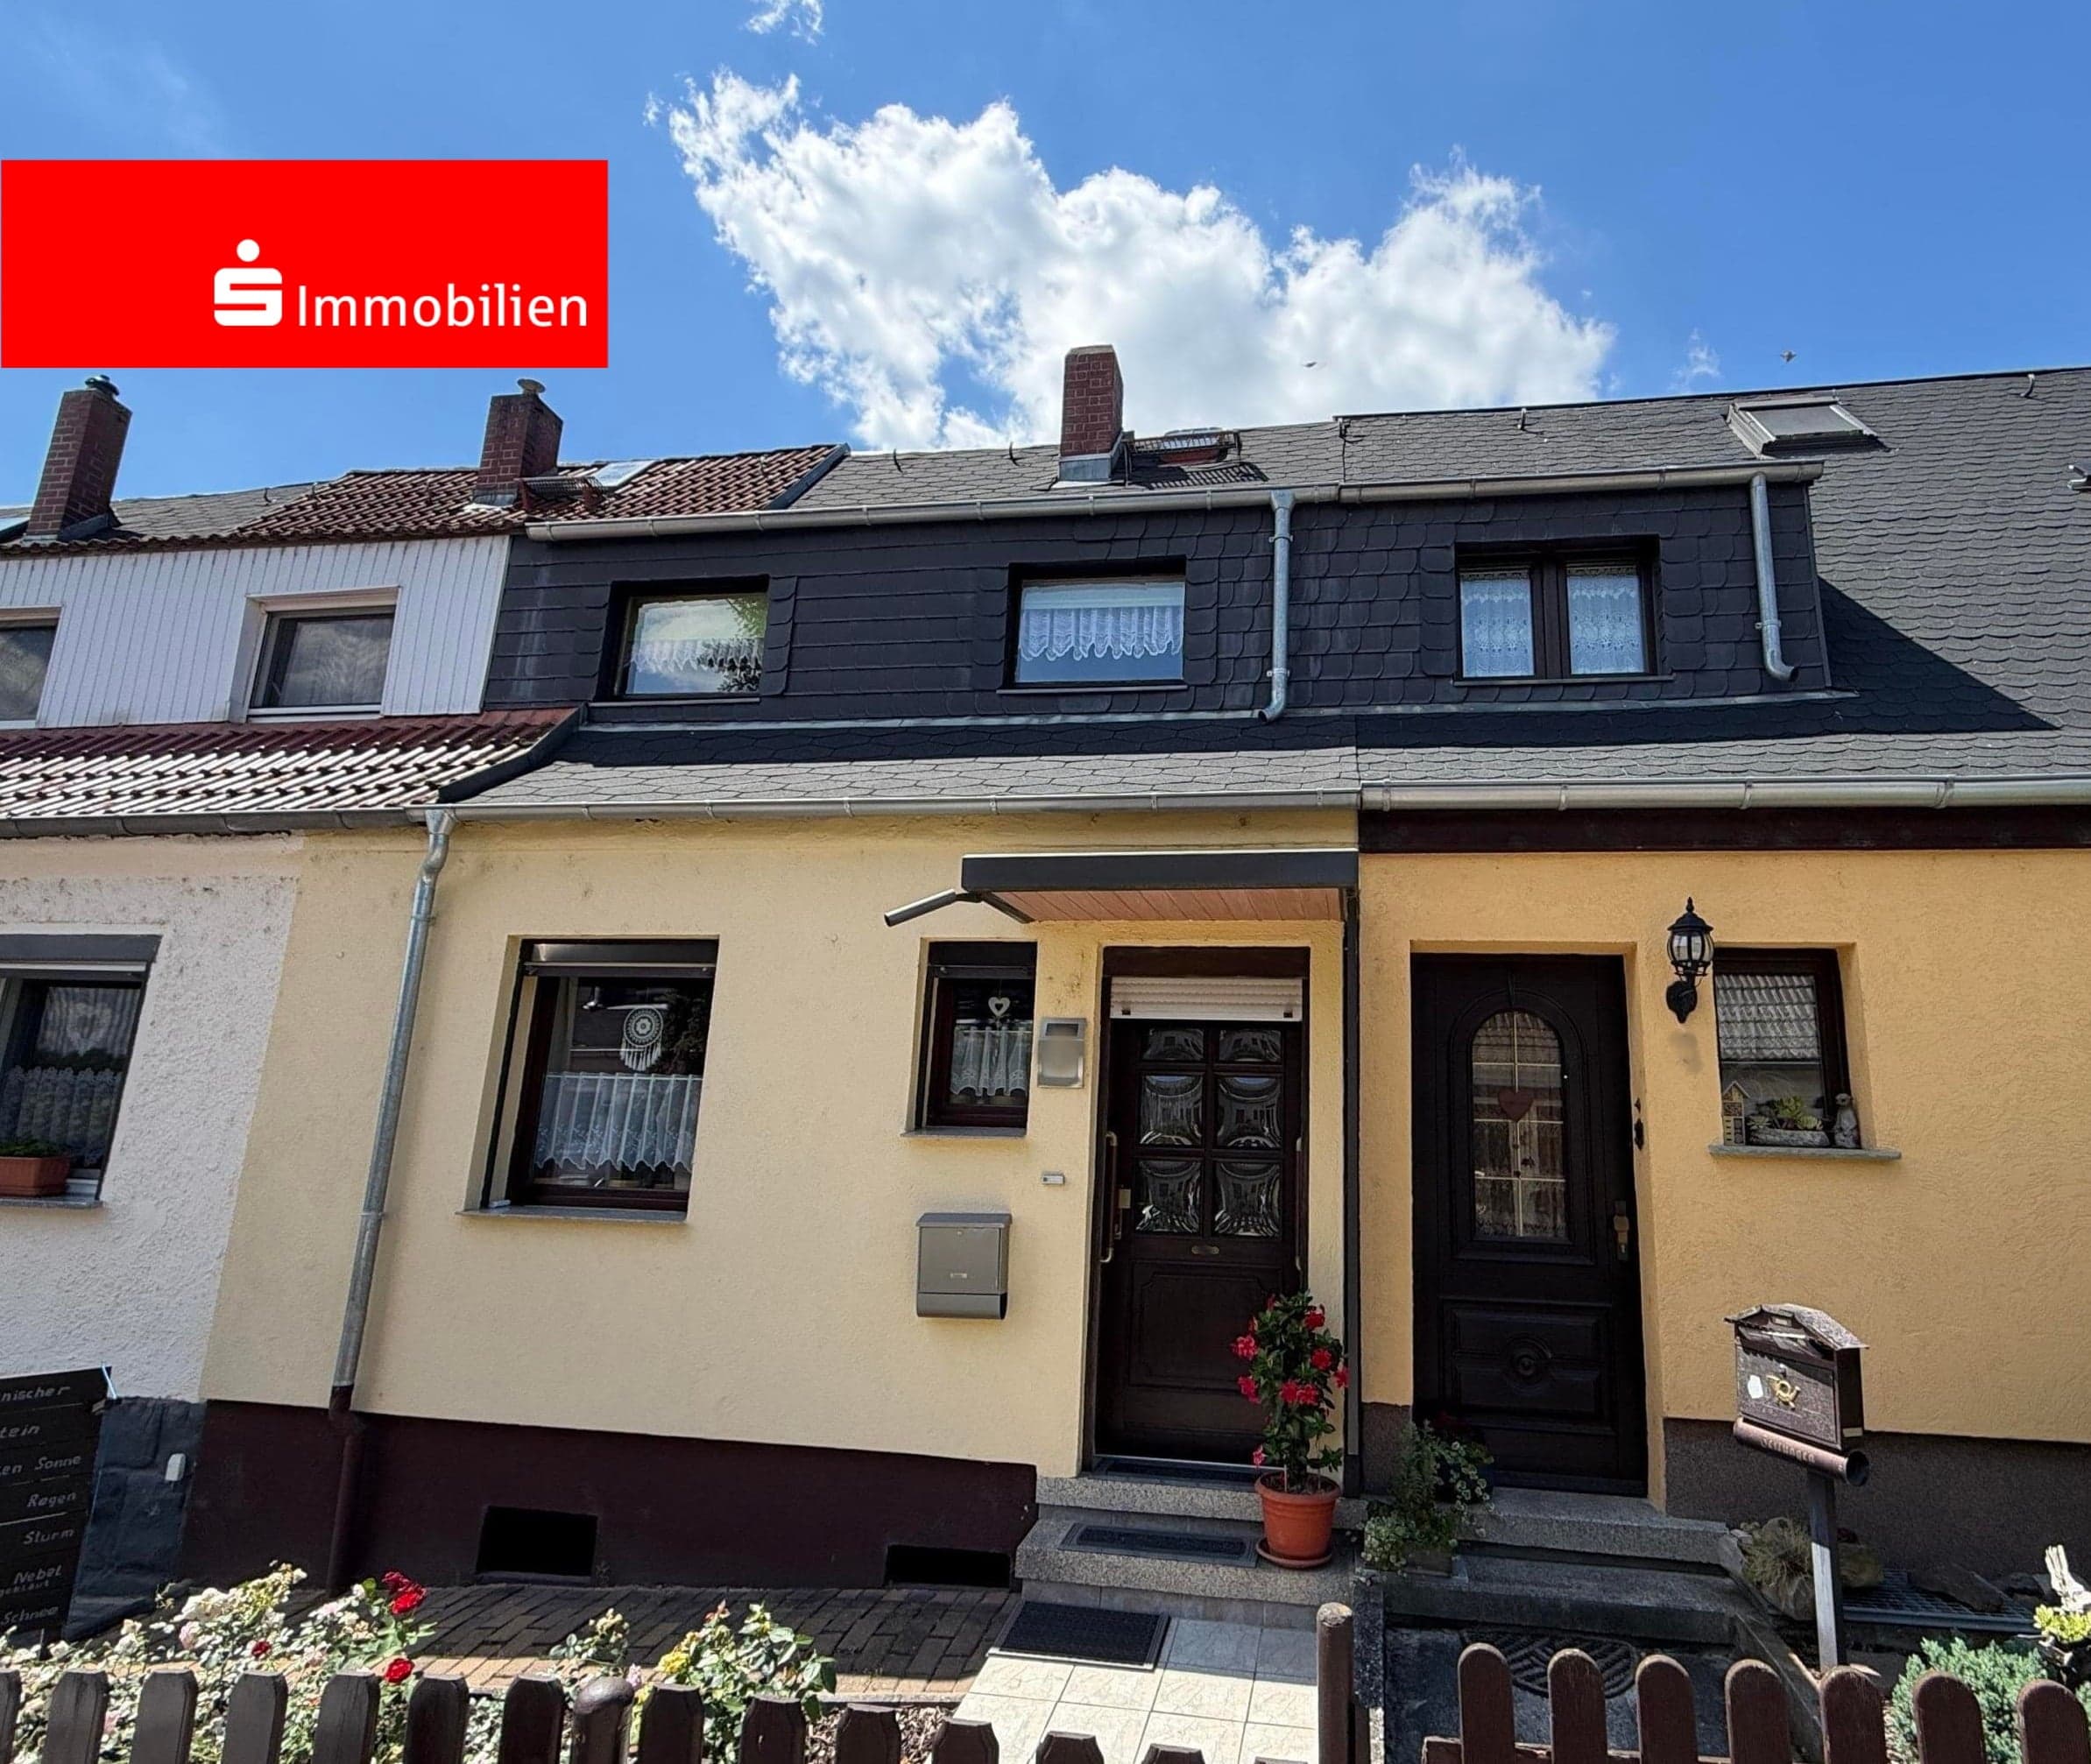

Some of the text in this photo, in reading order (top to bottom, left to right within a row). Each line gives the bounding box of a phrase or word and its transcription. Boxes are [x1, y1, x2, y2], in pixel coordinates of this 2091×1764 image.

[0, 1455, 82, 1477] en Sonne
[26, 1491, 77, 1507] Regen
[23, 1528, 75, 1546] Sturm
[13, 1564, 63, 1584] Nebel
[0, 1605, 60, 1626] Schnee
